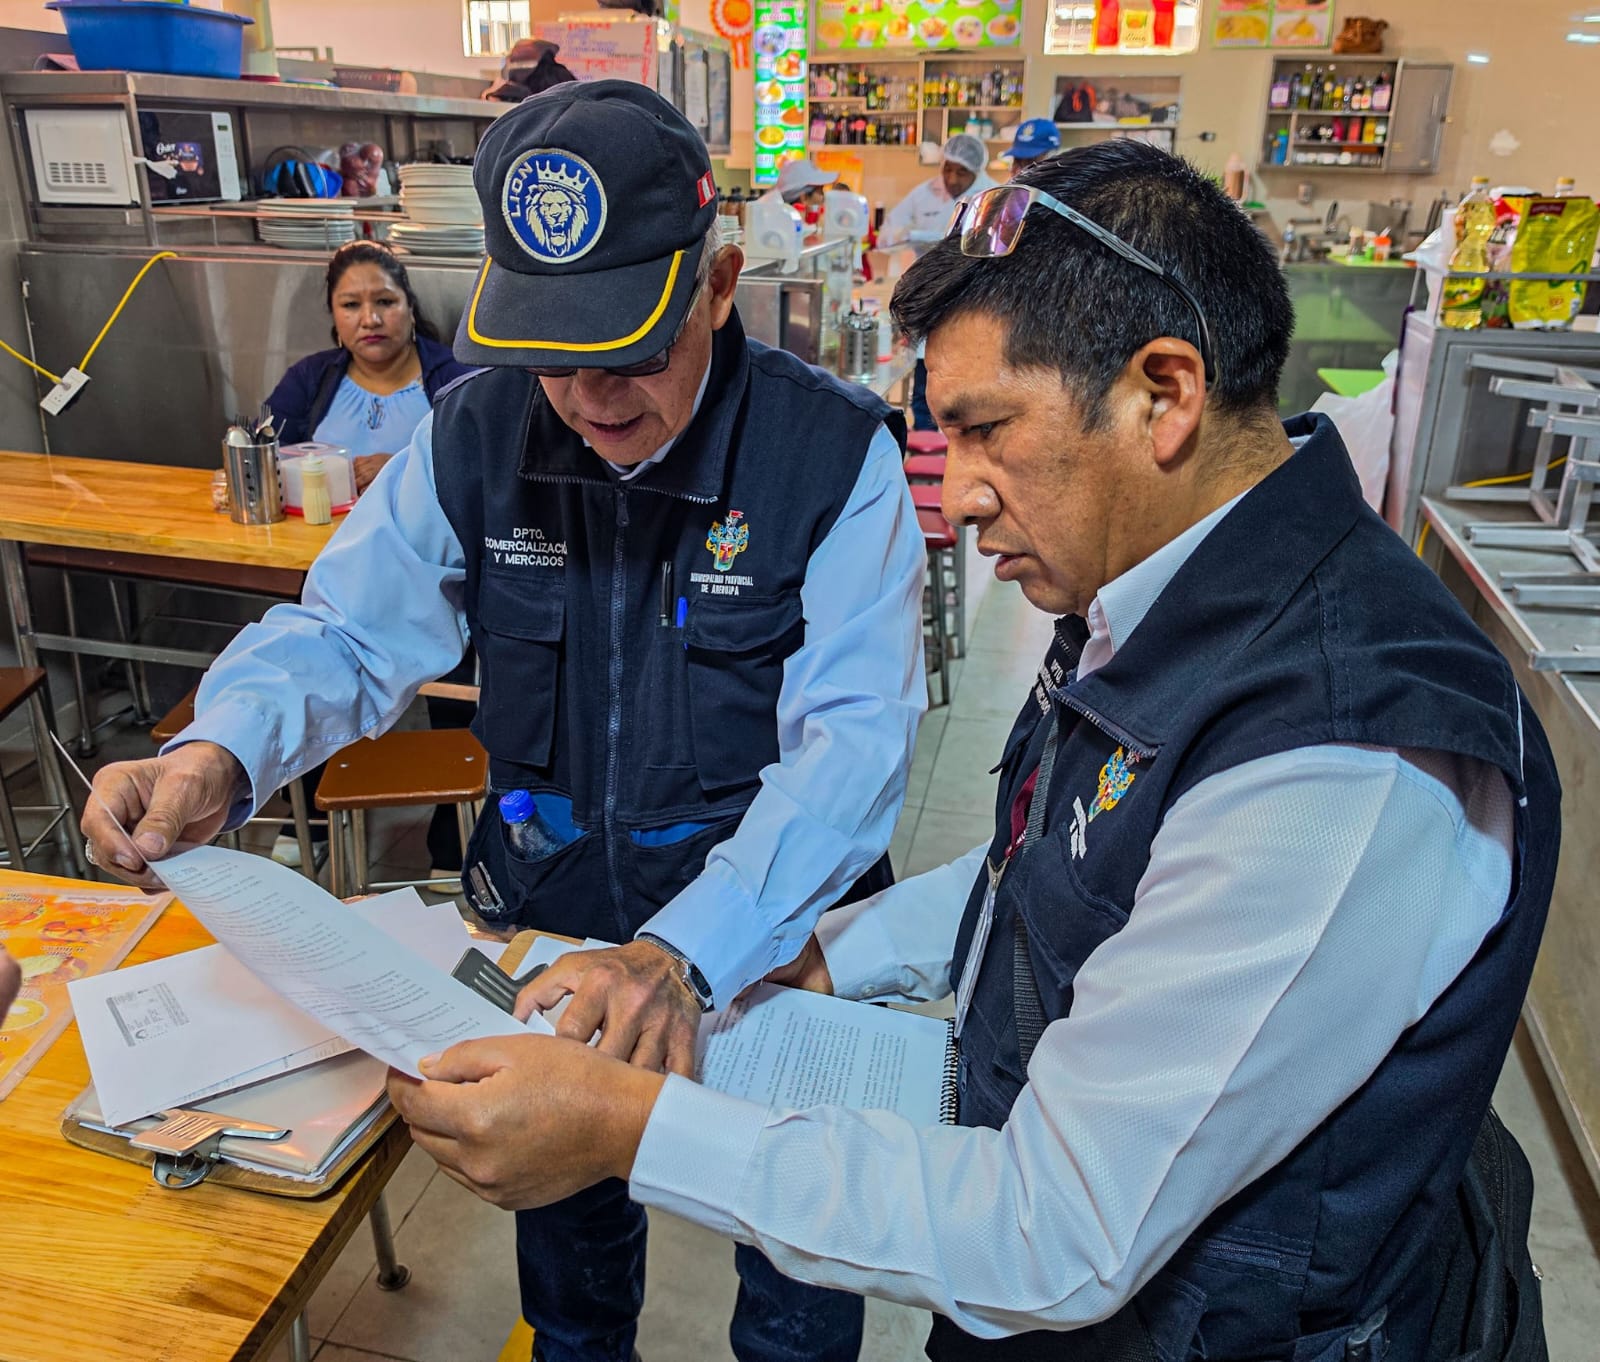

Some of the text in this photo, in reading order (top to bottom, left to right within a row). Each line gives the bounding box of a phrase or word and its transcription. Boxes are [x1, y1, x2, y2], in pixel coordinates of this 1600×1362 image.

[510, 162, 533, 217] LION
[494, 552, 564, 566] Y MERCADOS
[701, 583, 709, 593] DE
